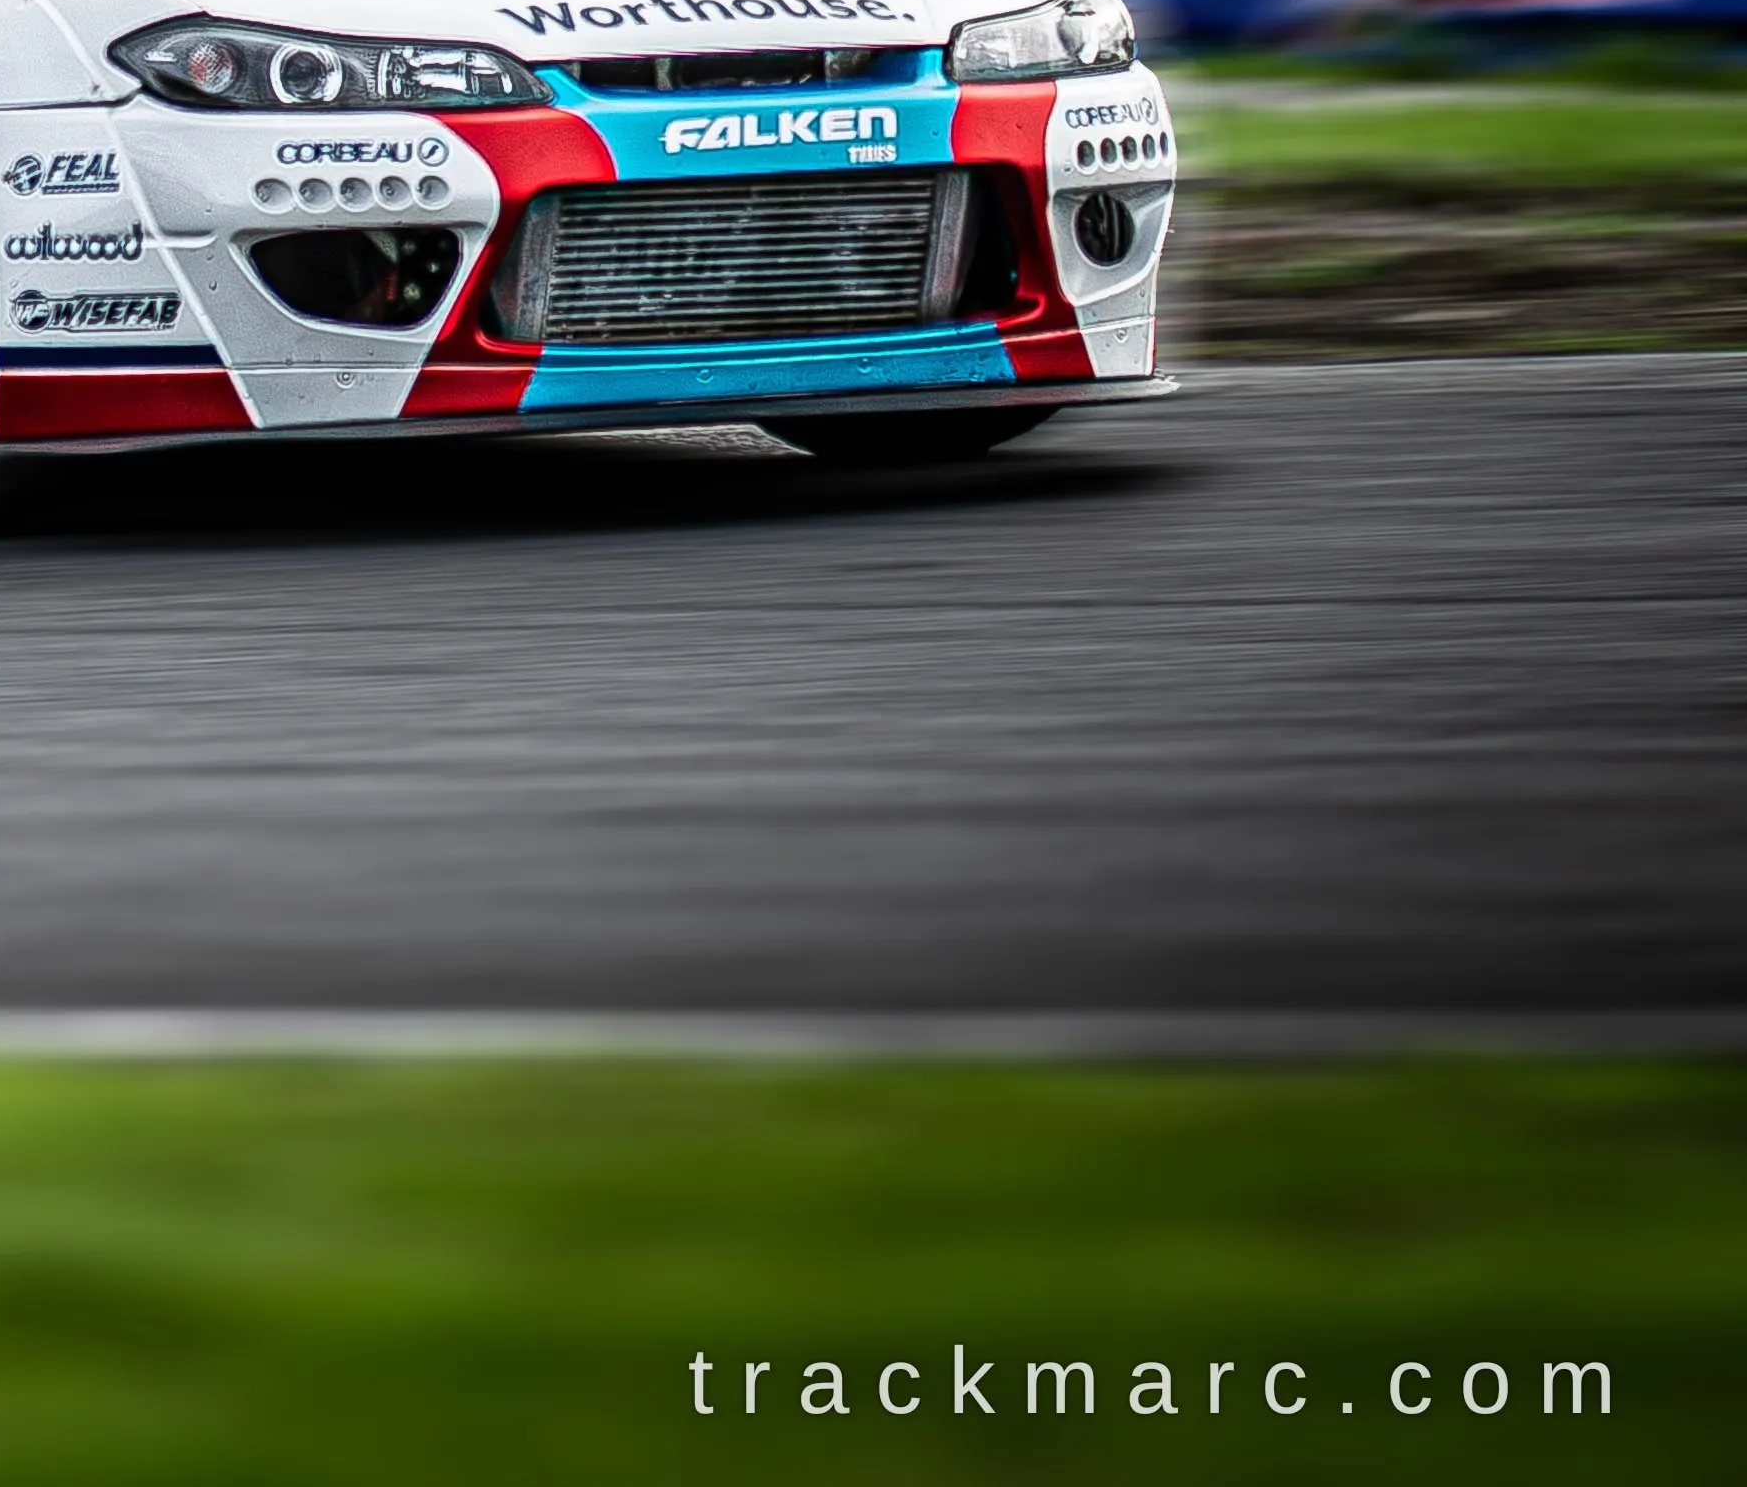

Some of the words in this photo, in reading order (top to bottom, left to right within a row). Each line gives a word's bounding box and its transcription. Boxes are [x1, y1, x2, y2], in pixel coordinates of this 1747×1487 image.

[657, 107, 899, 154] FALKEN
[45, 152, 121, 183] FEAL
[277, 141, 413, 164] CORBEAU
[6, 220, 145, 261] wilwood
[52, 298, 182, 327] WISEFAB
